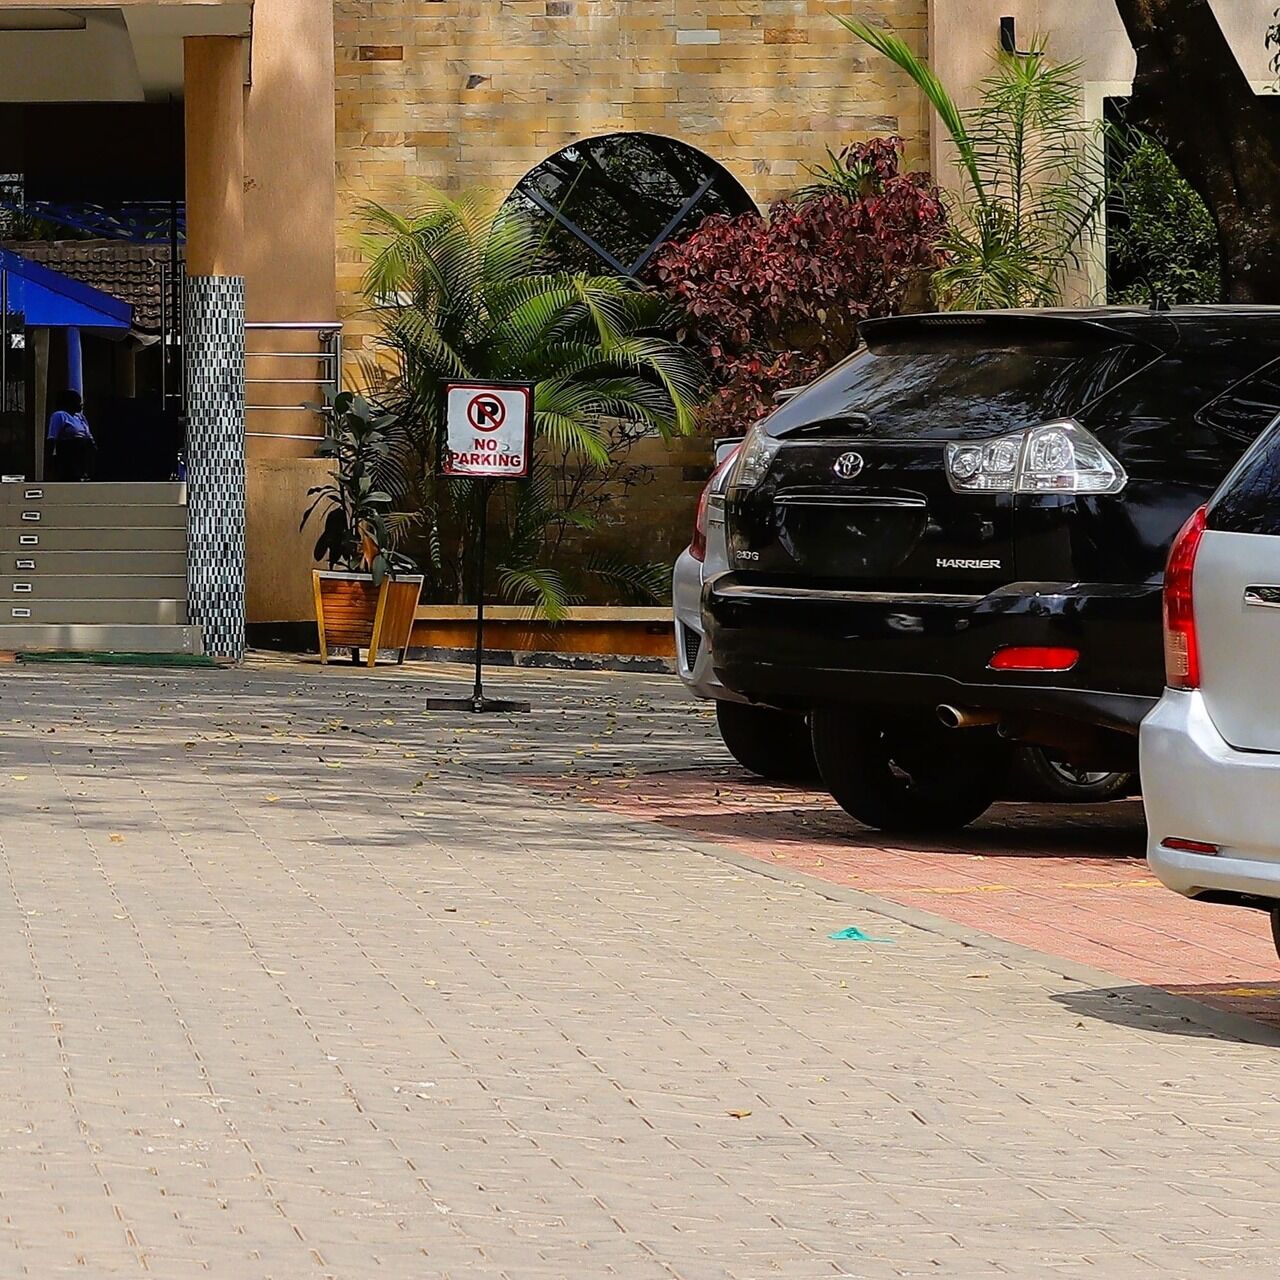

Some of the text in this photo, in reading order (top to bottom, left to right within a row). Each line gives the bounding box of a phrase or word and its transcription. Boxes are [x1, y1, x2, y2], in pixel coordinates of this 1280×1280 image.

[474, 438, 497, 451] NO
[451, 452, 521, 467] PARKING
[936, 558, 1001, 569] HARRIER
